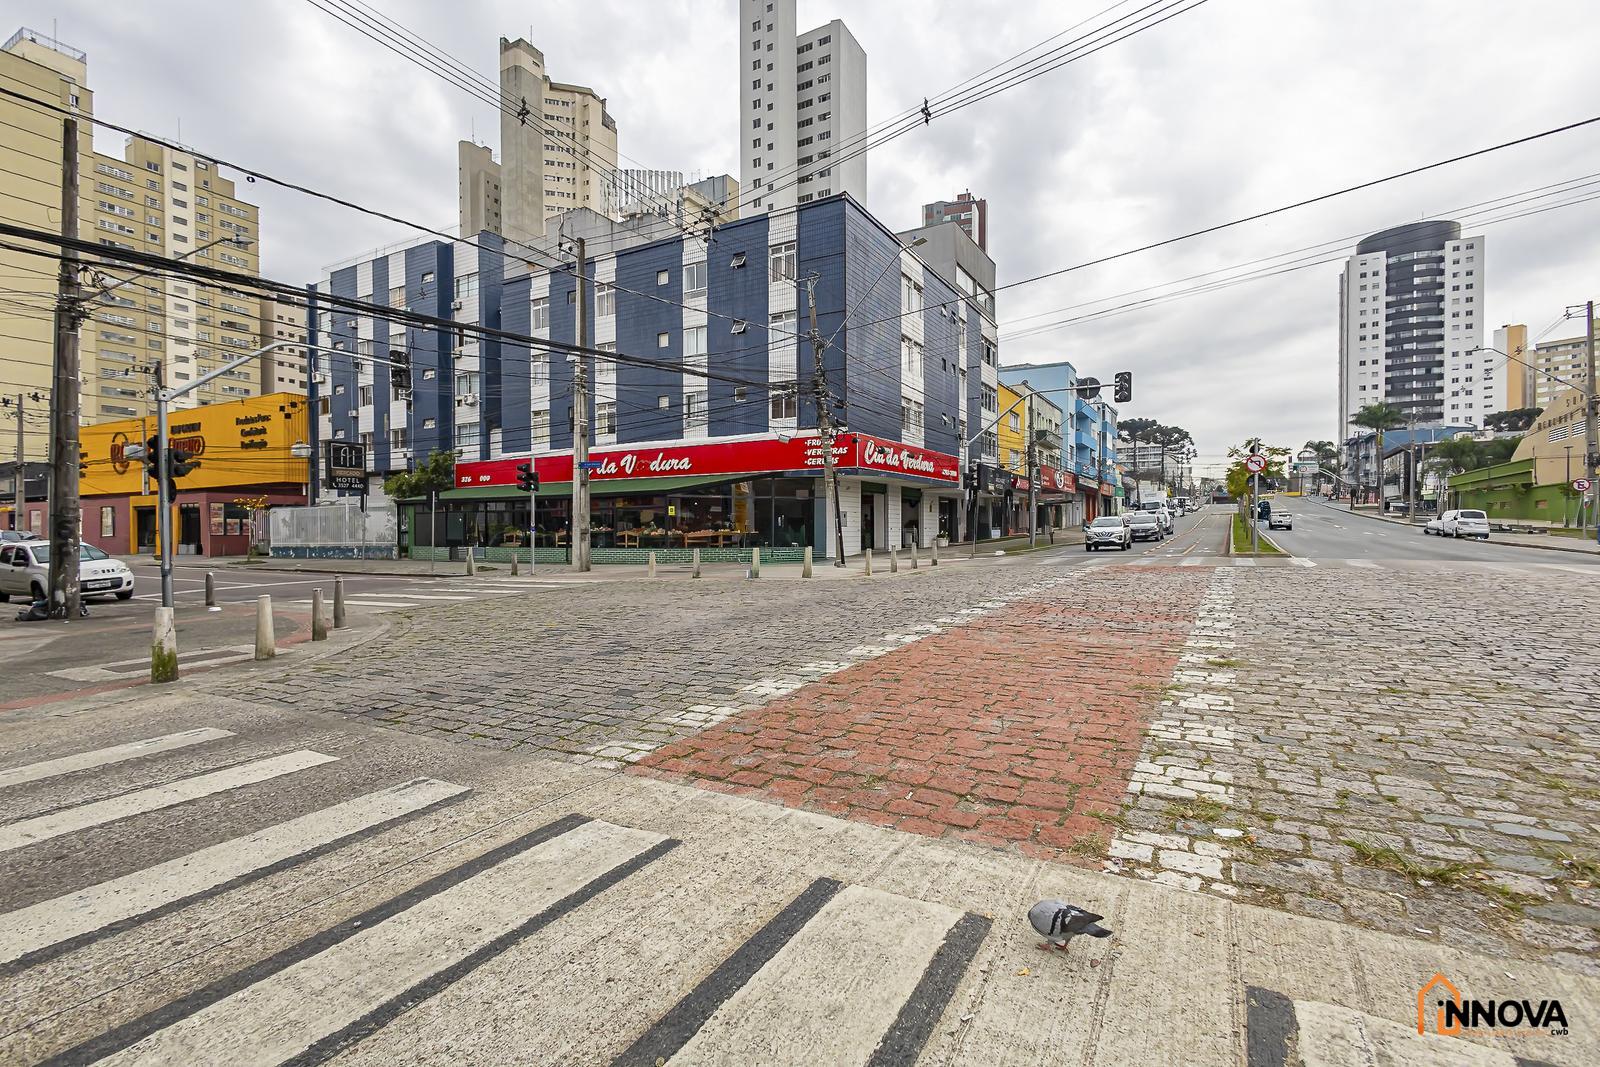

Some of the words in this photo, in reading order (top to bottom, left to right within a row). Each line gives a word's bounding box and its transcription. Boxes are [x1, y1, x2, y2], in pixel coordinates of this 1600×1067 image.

[807, 439, 835, 447] FRUS
[807, 447, 849, 456] VERRAS
[807, 457, 840, 465] CEREIS
